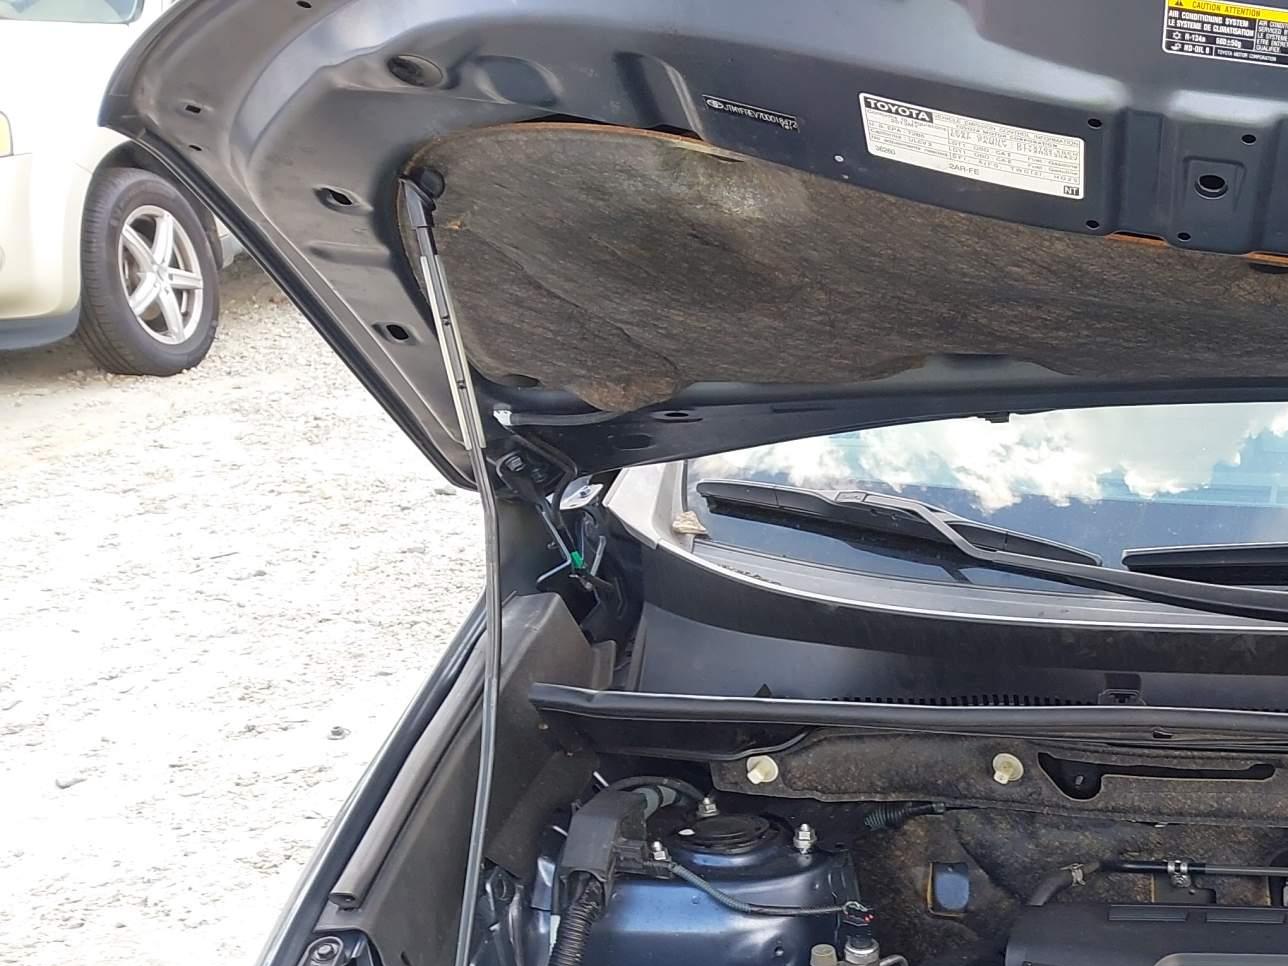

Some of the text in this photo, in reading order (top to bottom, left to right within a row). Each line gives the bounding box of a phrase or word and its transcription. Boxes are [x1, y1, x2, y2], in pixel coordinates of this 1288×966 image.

[1192, 1, 1261, 17] CAUTION ATTENTION
[1168, 9, 1248, 26] AIR CONDITIONING SYSTEM
[1213, 24, 1253, 36] CLIMATISATION
[866, 98, 930, 121] TOYOTA
[1065, 187, 1079, 195] NT
